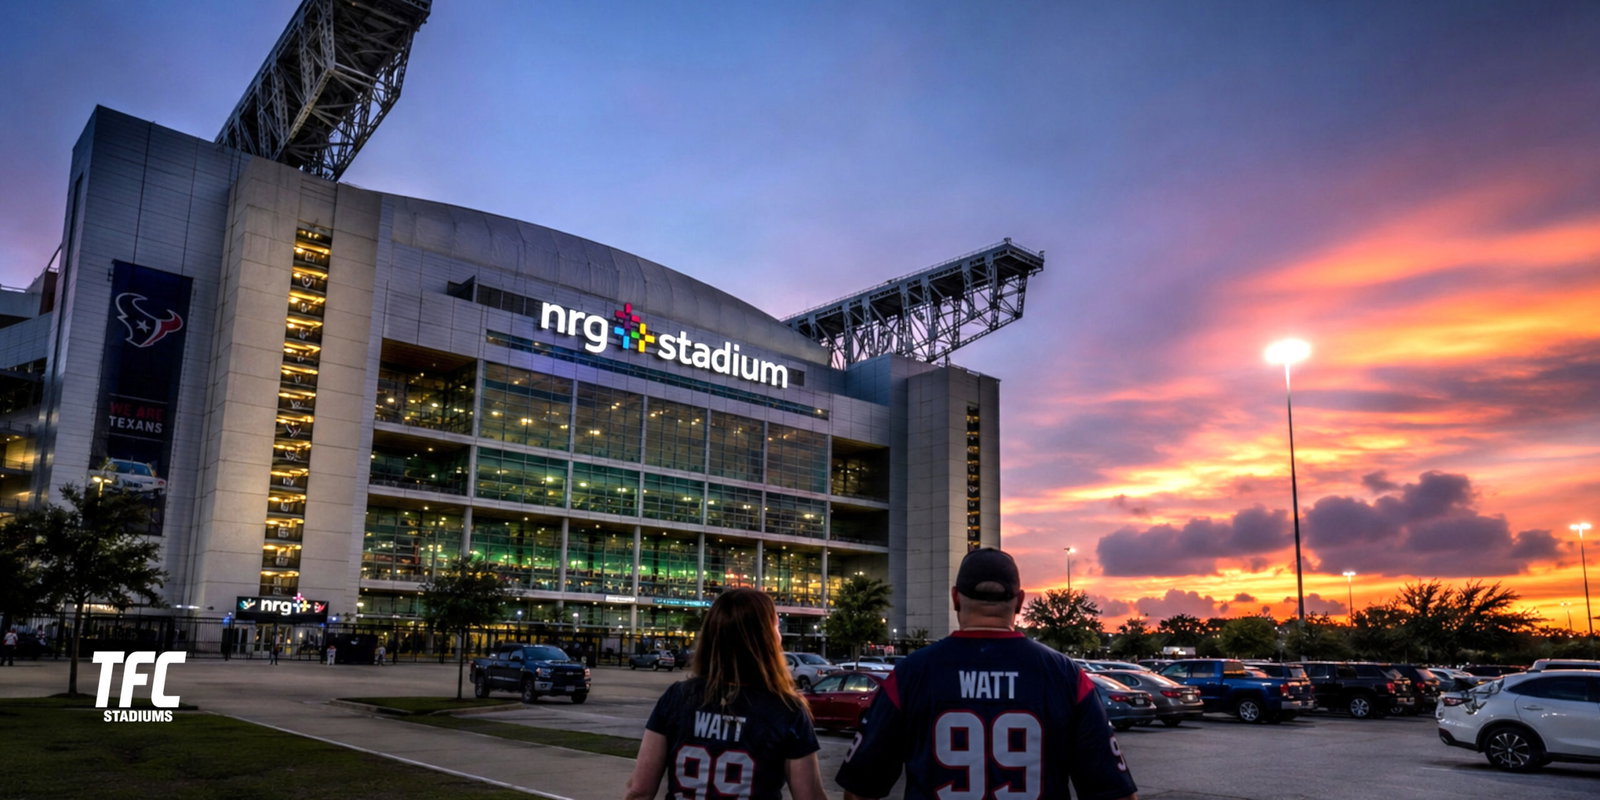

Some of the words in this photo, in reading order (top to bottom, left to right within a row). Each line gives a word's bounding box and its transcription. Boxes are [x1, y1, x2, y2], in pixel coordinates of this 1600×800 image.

[540, 302, 609, 353] nrg
[657, 331, 789, 389] stadium
[108, 415, 163, 434] TEXANS
[110, 402, 131, 417] WE
[136, 407, 164, 421] ARE
[260, 598, 292, 616] nrg
[958, 670, 1019, 700] WATT
[693, 711, 747, 743] WATT
[932, 708, 1044, 800] 99
[674, 744, 755, 800] 99
